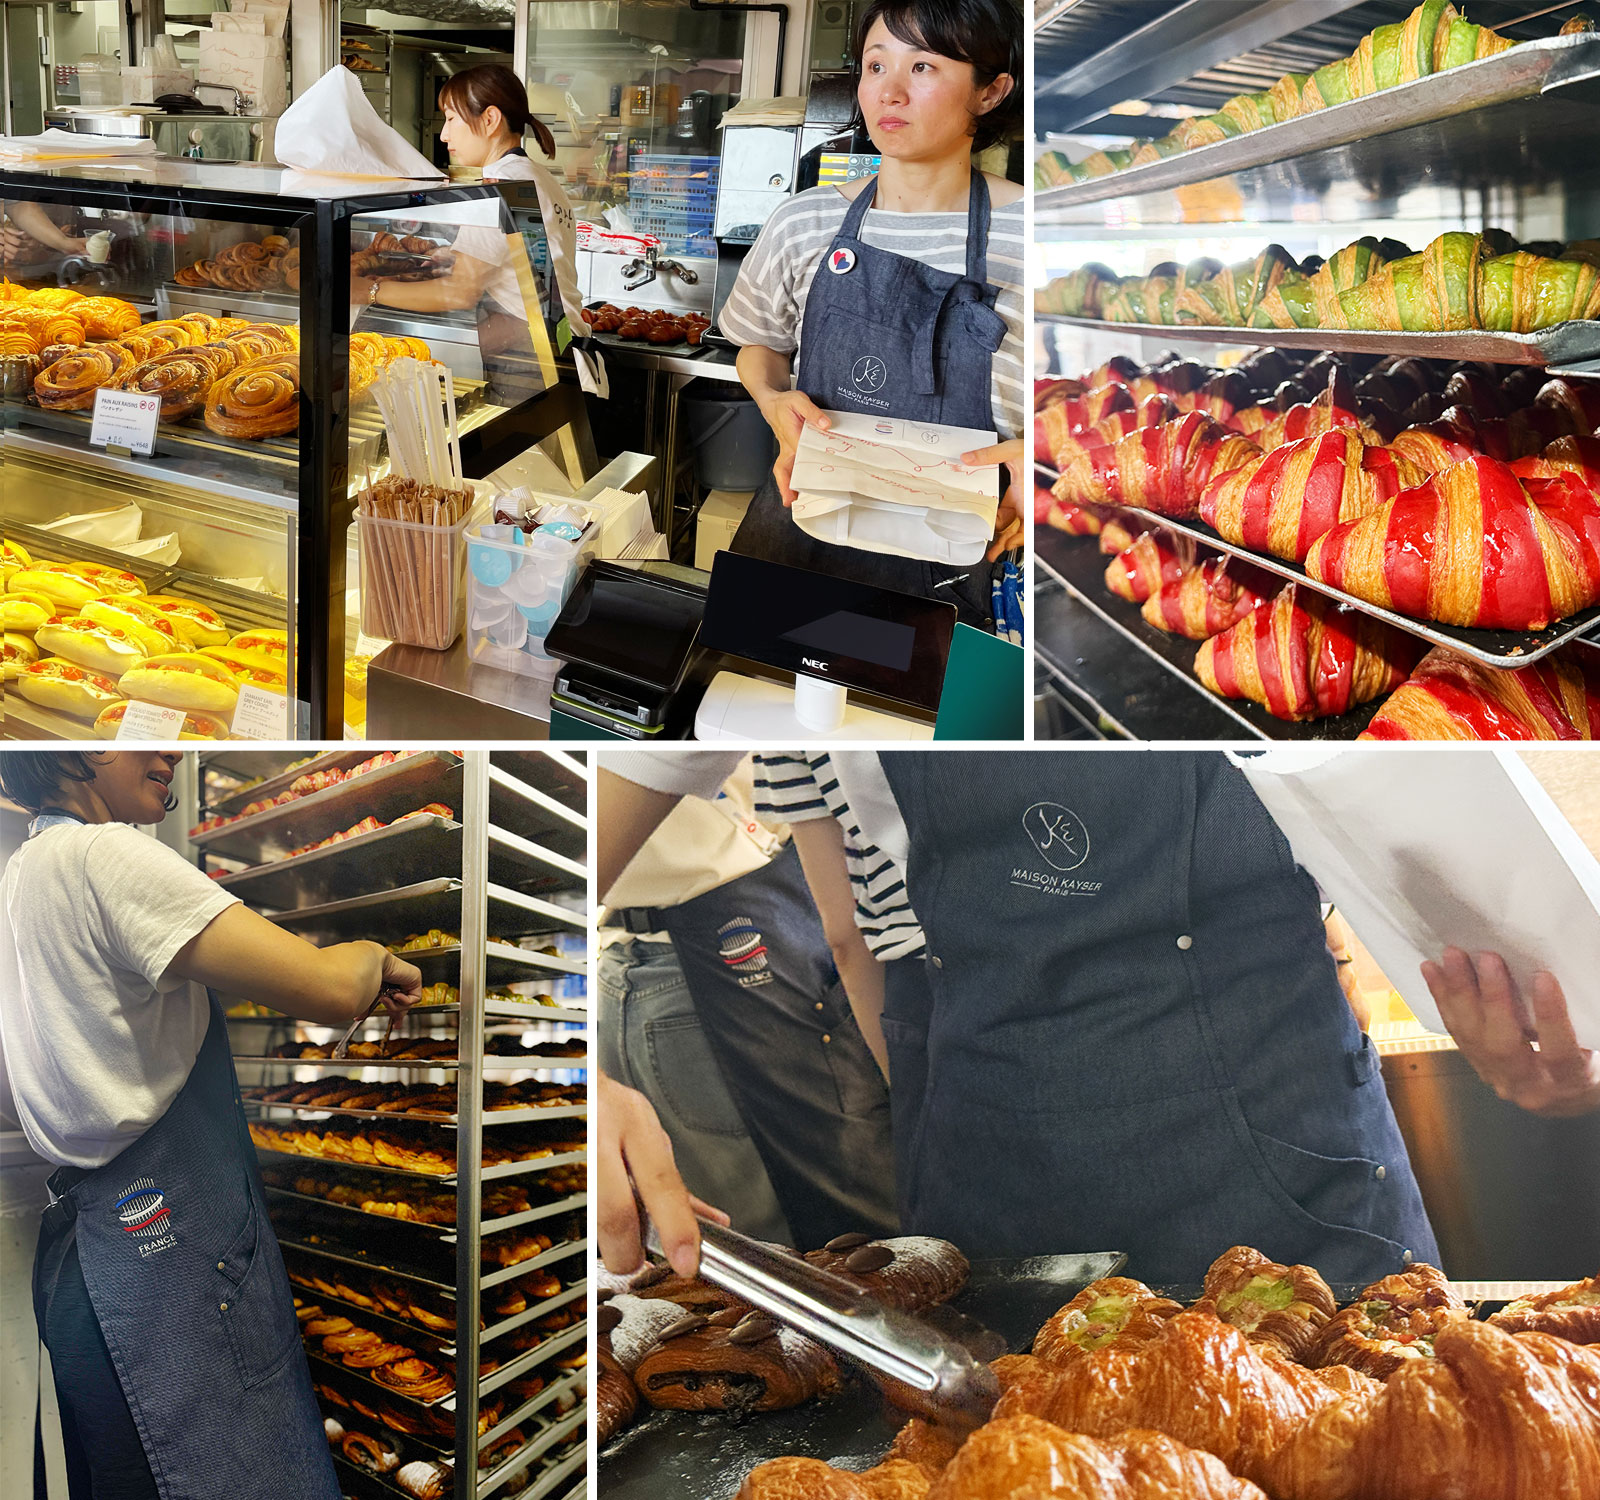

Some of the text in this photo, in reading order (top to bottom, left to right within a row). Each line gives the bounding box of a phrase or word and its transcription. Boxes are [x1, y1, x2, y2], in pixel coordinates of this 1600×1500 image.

[101, 397, 112, 405] PAIN
[121, 401, 138, 409] RAISINS
[837, 386, 890, 408] MAISON KAYSER
[853, 397, 869, 406] PARIS
[801, 657, 829, 671] NEC
[1010, 868, 1103, 891] MAISON KAYSER
[1042, 885, 1069, 896] PARIS
[138, 1232, 177, 1254] FRANCE
